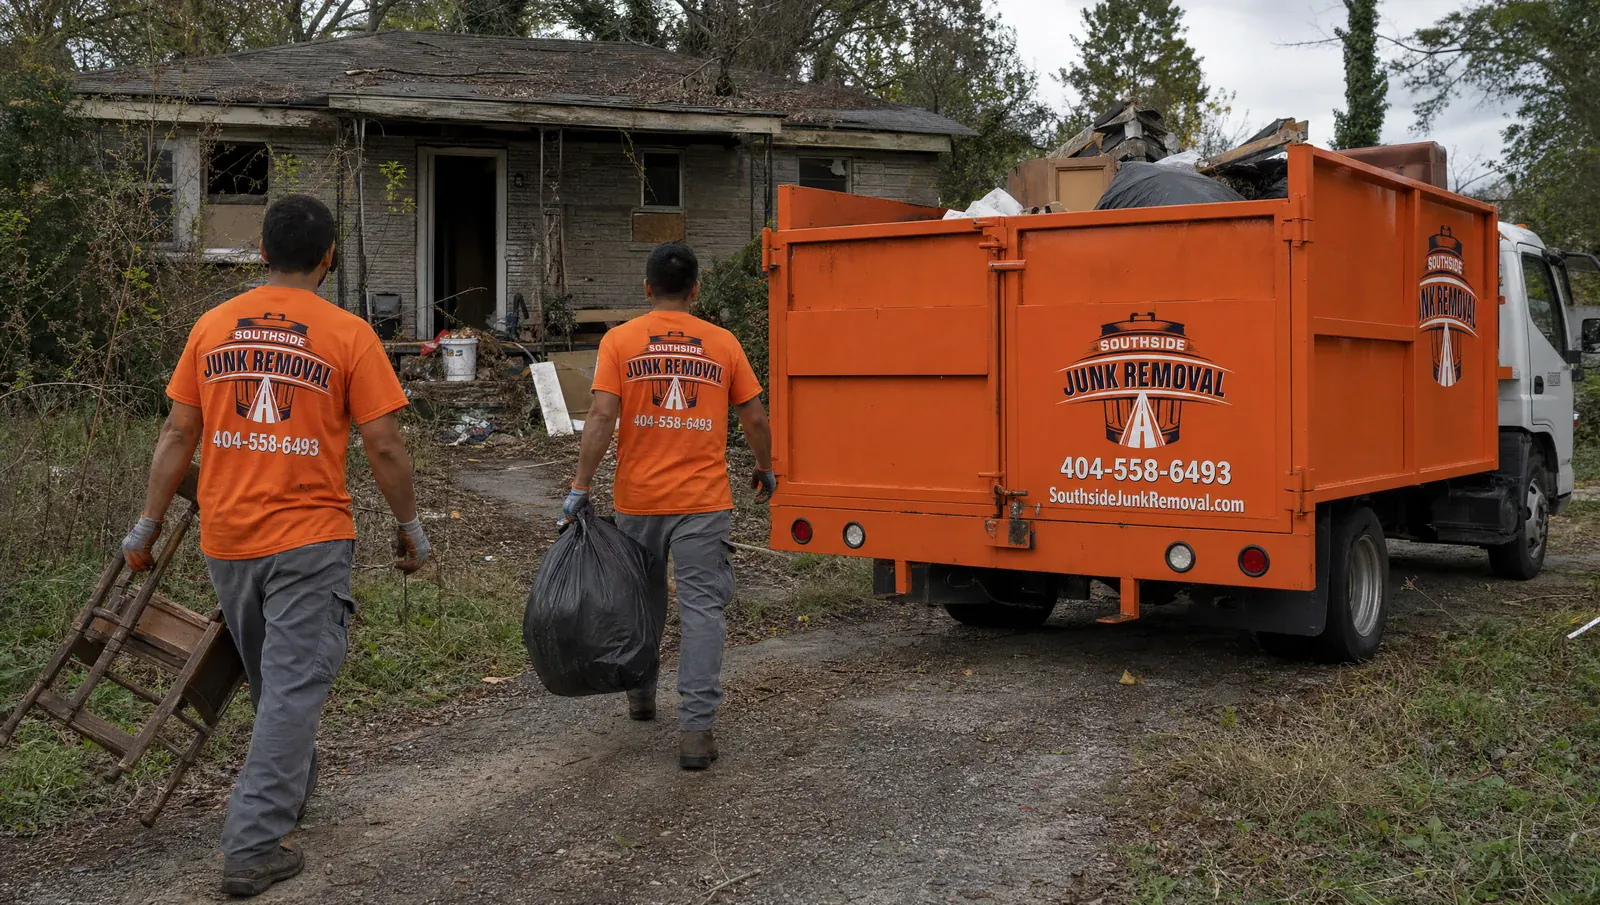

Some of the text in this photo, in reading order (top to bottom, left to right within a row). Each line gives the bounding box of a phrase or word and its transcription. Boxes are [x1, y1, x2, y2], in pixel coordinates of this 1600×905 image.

[1428, 255, 1463, 275] SOUTHSIDE
[1419, 285, 1477, 330] NK REMOVAL
[234, 330, 306, 347] SOUTHSIDE
[649, 344, 703, 355] SOUTHSIDE
[1100, 336, 1186, 351] SOUTHSIDE
[204, 350, 333, 390] JUNK REMOVAL
[626, 358, 723, 383] JUNK REMOVAL
[1063, 361, 1226, 398] JUNK REMOVAL
[633, 414, 713, 432] 404-558-6493
[212, 430, 320, 457] 404-558-6493
[1060, 456, 1232, 485] 404-558-6493
[1049, 486, 1245, 513] SouthsideJunkRemoval.com
